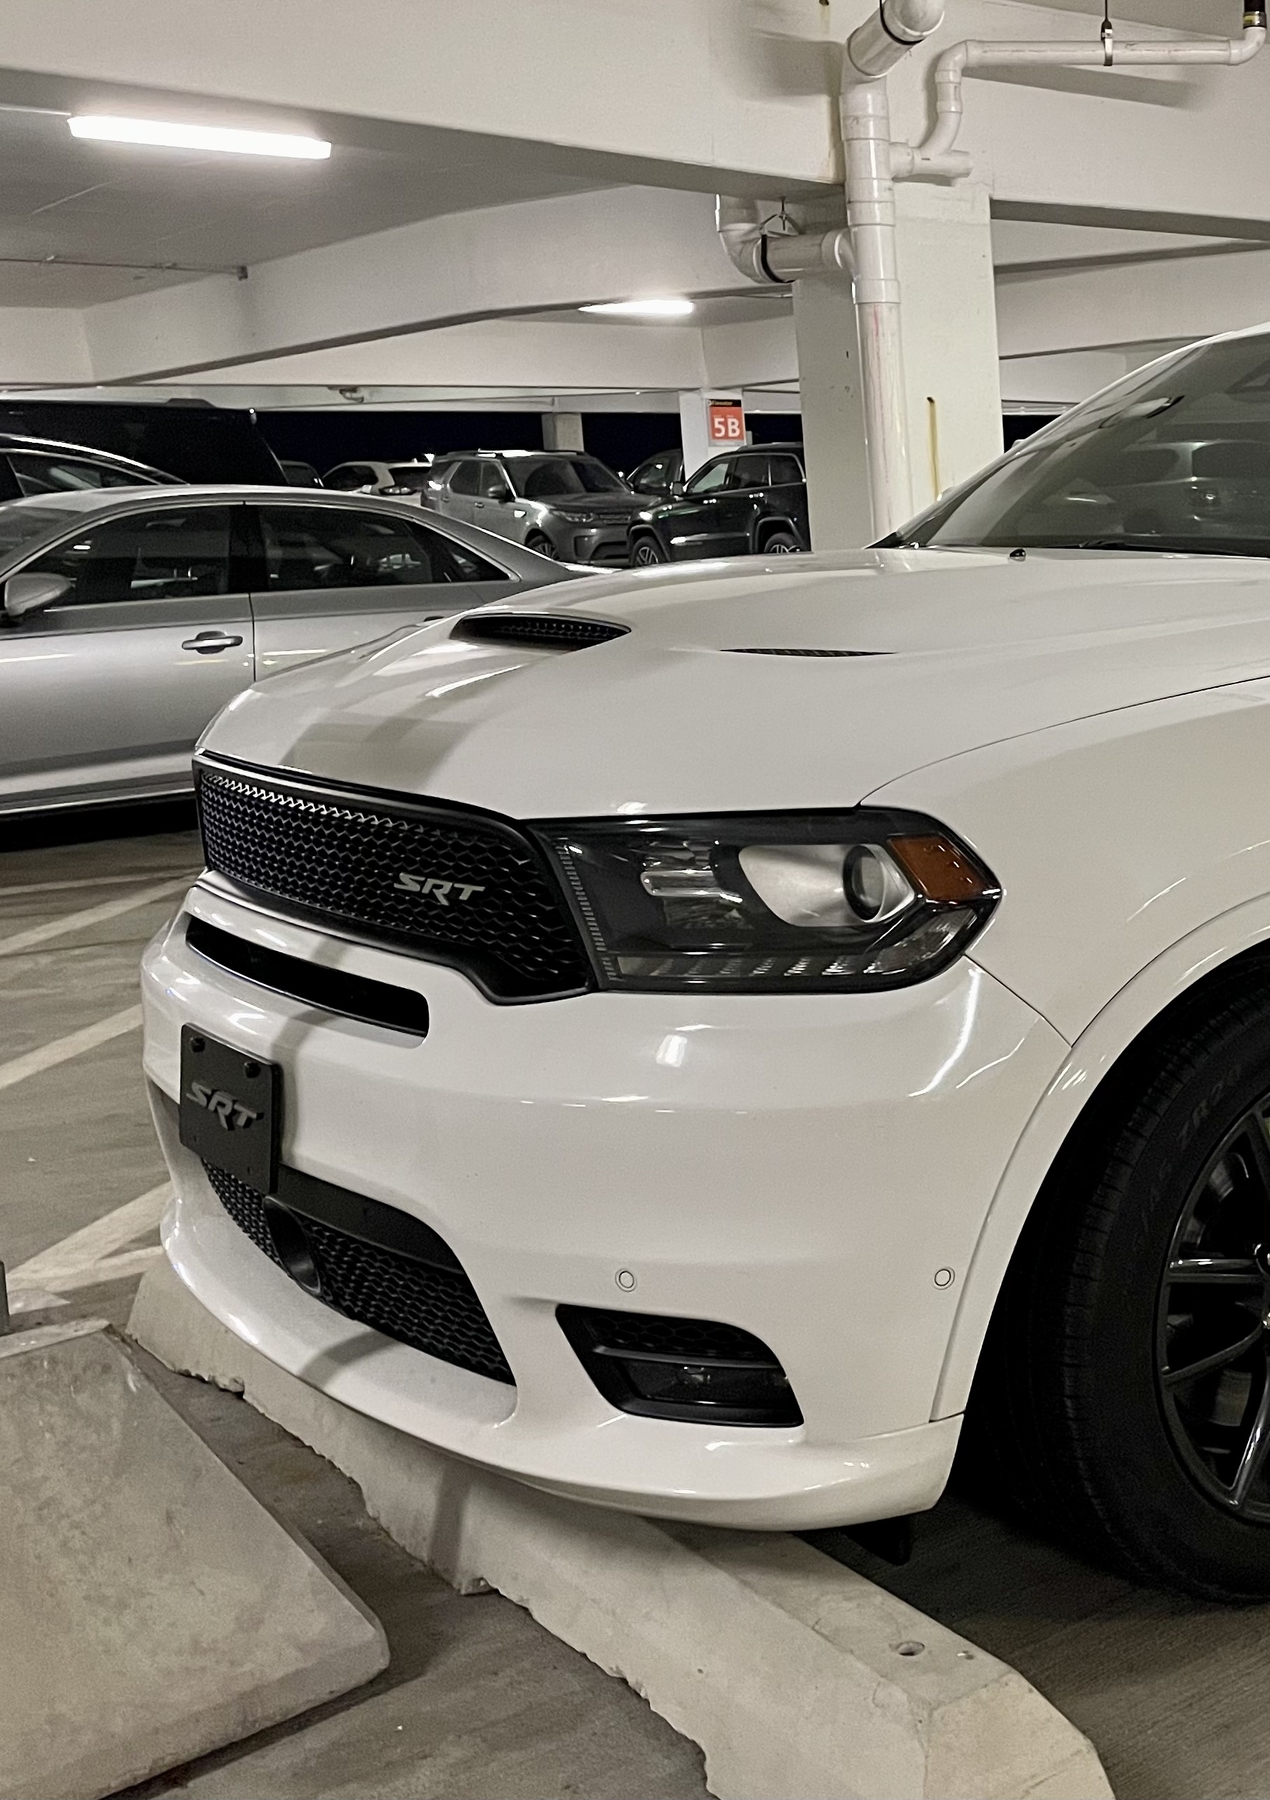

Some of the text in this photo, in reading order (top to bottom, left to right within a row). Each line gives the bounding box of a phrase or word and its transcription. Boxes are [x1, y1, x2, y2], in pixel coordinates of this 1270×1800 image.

[714, 418, 740, 437] 5B
[394, 872, 485, 906] SRT
[186, 1082, 257, 1130] SRT
